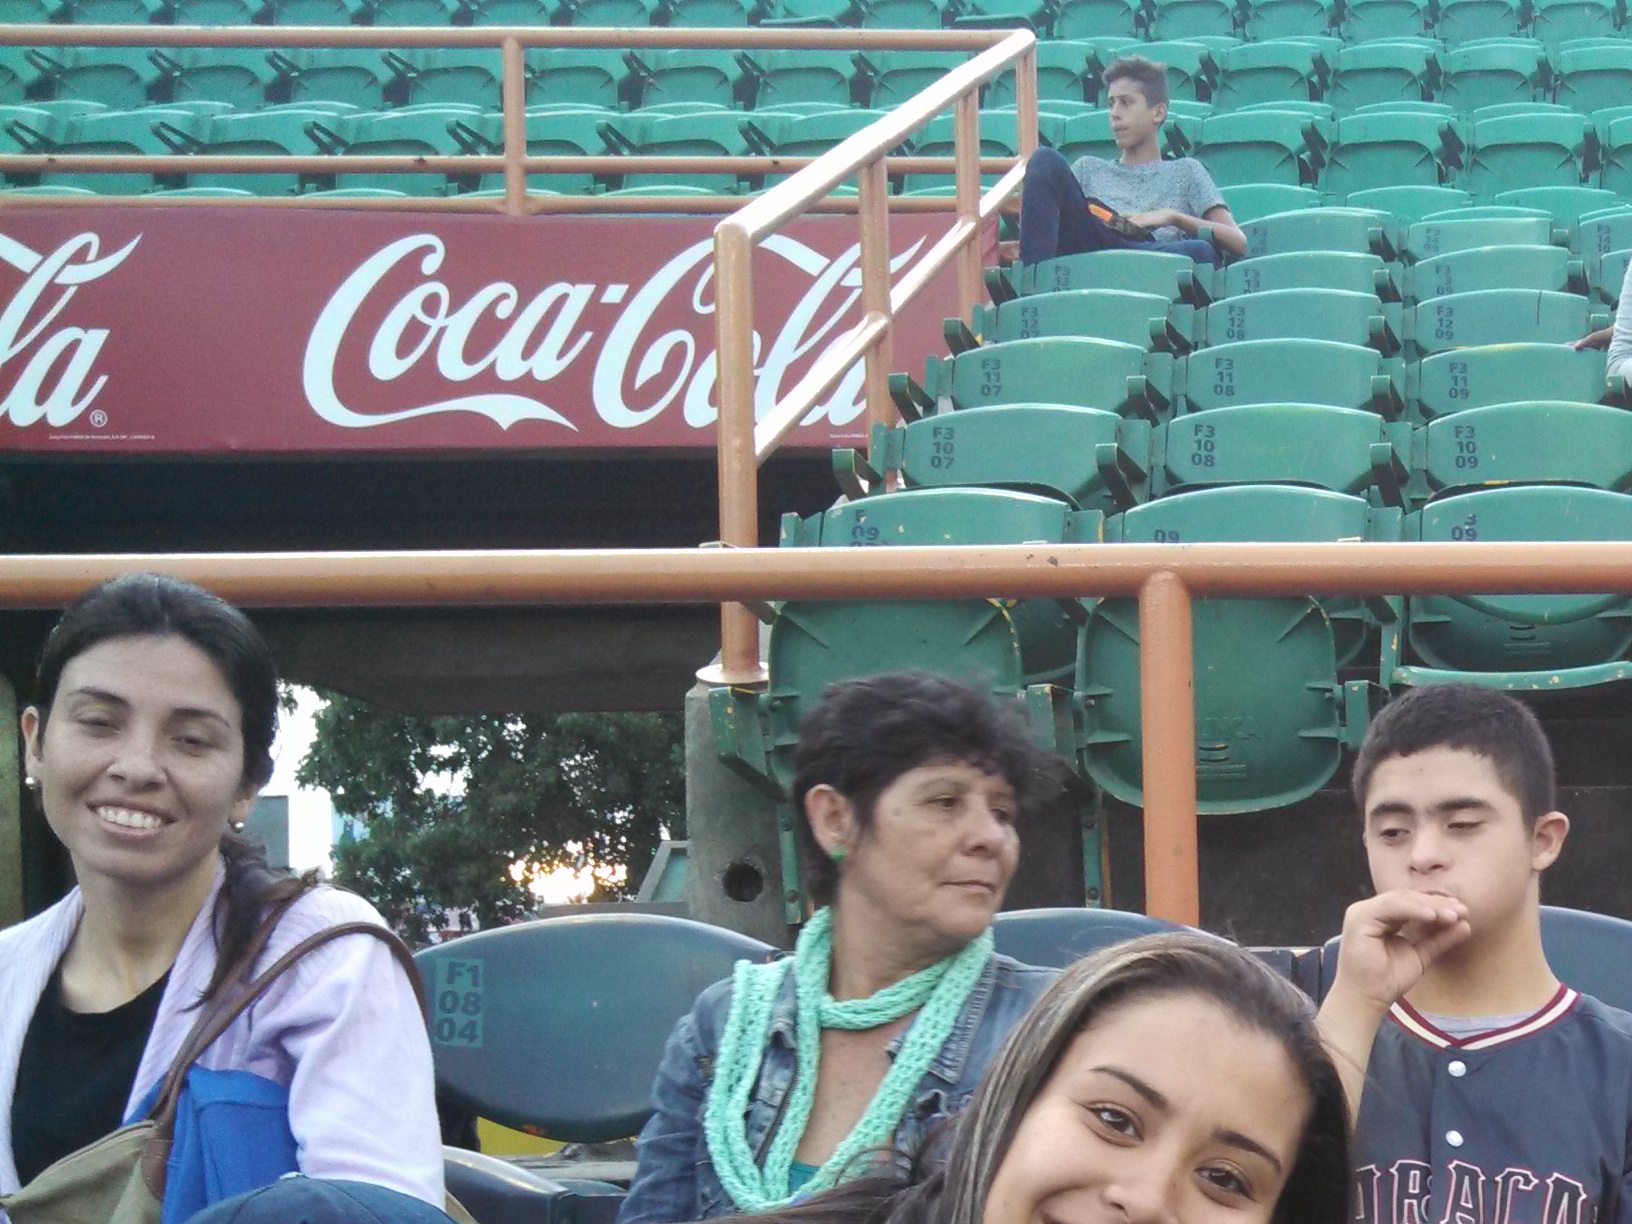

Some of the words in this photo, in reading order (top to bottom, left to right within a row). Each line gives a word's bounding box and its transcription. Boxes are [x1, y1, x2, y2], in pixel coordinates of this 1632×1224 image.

[1021, 307, 1038, 317] F3
[1228, 305, 1245, 316] F3
[1437, 306, 1453, 316] F3
[1229, 317, 1244, 327] 12
[1438, 318, 1453, 328] 12
[1227, 329, 1245, 338] 08
[981, 358, 1000, 370] F3
[1214, 358, 1234, 369] F3
[1449, 362, 1468, 373] F3
[986, 371, 1000, 382] 11
[1217, 371, 1234, 382] 11
[1451, 375, 1467, 386] 11
[981, 385, 1002, 396] 07
[1213, 384, 1235, 396] 08
[1449, 388, 1470, 399] 09
[933, 427, 954, 440] F3
[1194, 424, 1216, 438] F3
[1454, 425, 1475, 439] F3
[933, 442, 954, 454] 10
[1194, 440, 1215, 452] 10
[1457, 441, 1477, 454] 10
[931, 455, 954, 468] 07
[1191, 453, 1215, 467] 08
[1455, 455, 1478, 469] 09
[1154, 529, 1180, 543] 09
[1451, 526, 1477, 541] 09
[446, 961, 480, 988] F1
[440, 990, 481, 1016] 08
[437, 1017, 479, 1043] 04
